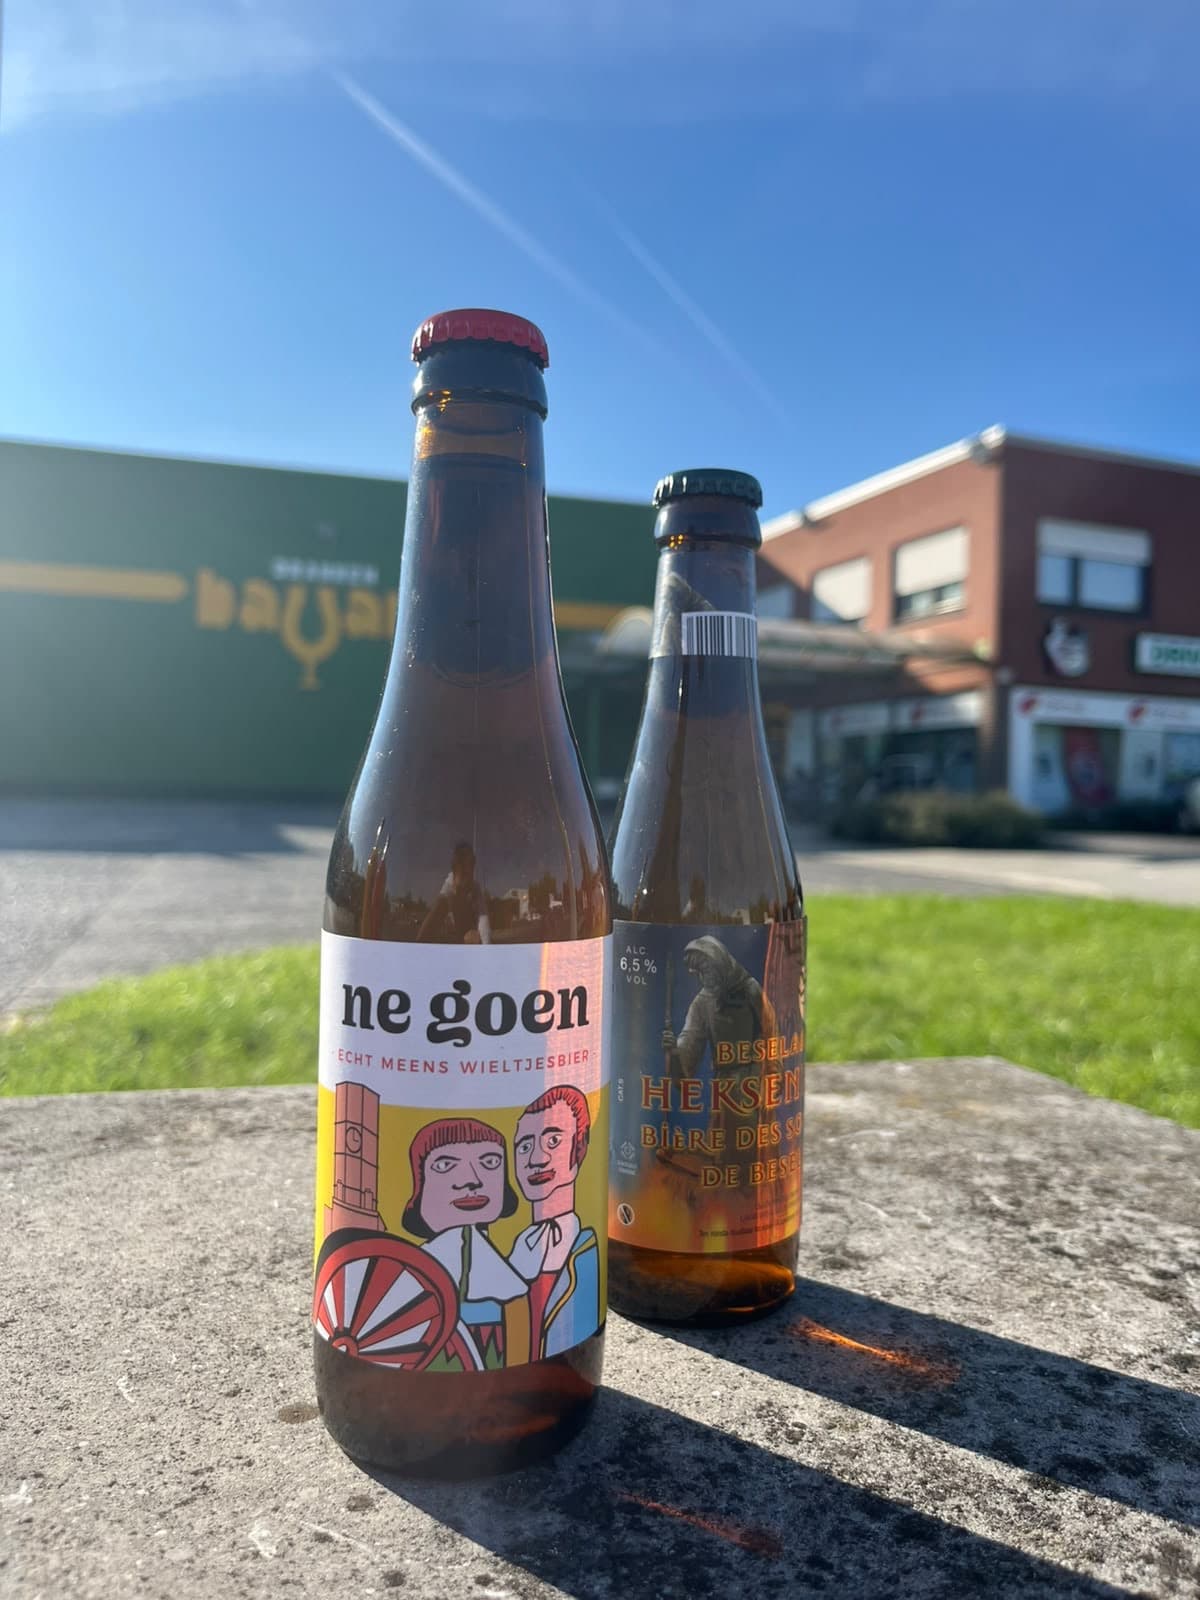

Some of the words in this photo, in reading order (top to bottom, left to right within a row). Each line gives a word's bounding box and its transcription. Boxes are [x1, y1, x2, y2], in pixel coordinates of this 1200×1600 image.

[341, 983, 411, 1034] ne
[426, 979, 590, 1048] goen
[337, 1048, 373, 1068] ECHT
[381, 1058, 449, 1074] MEENS
[460, 1049, 590, 1074] WIELTJESBIER
[736, 1121, 781, 1150] DES
[701, 1165, 739, 1188] DE
